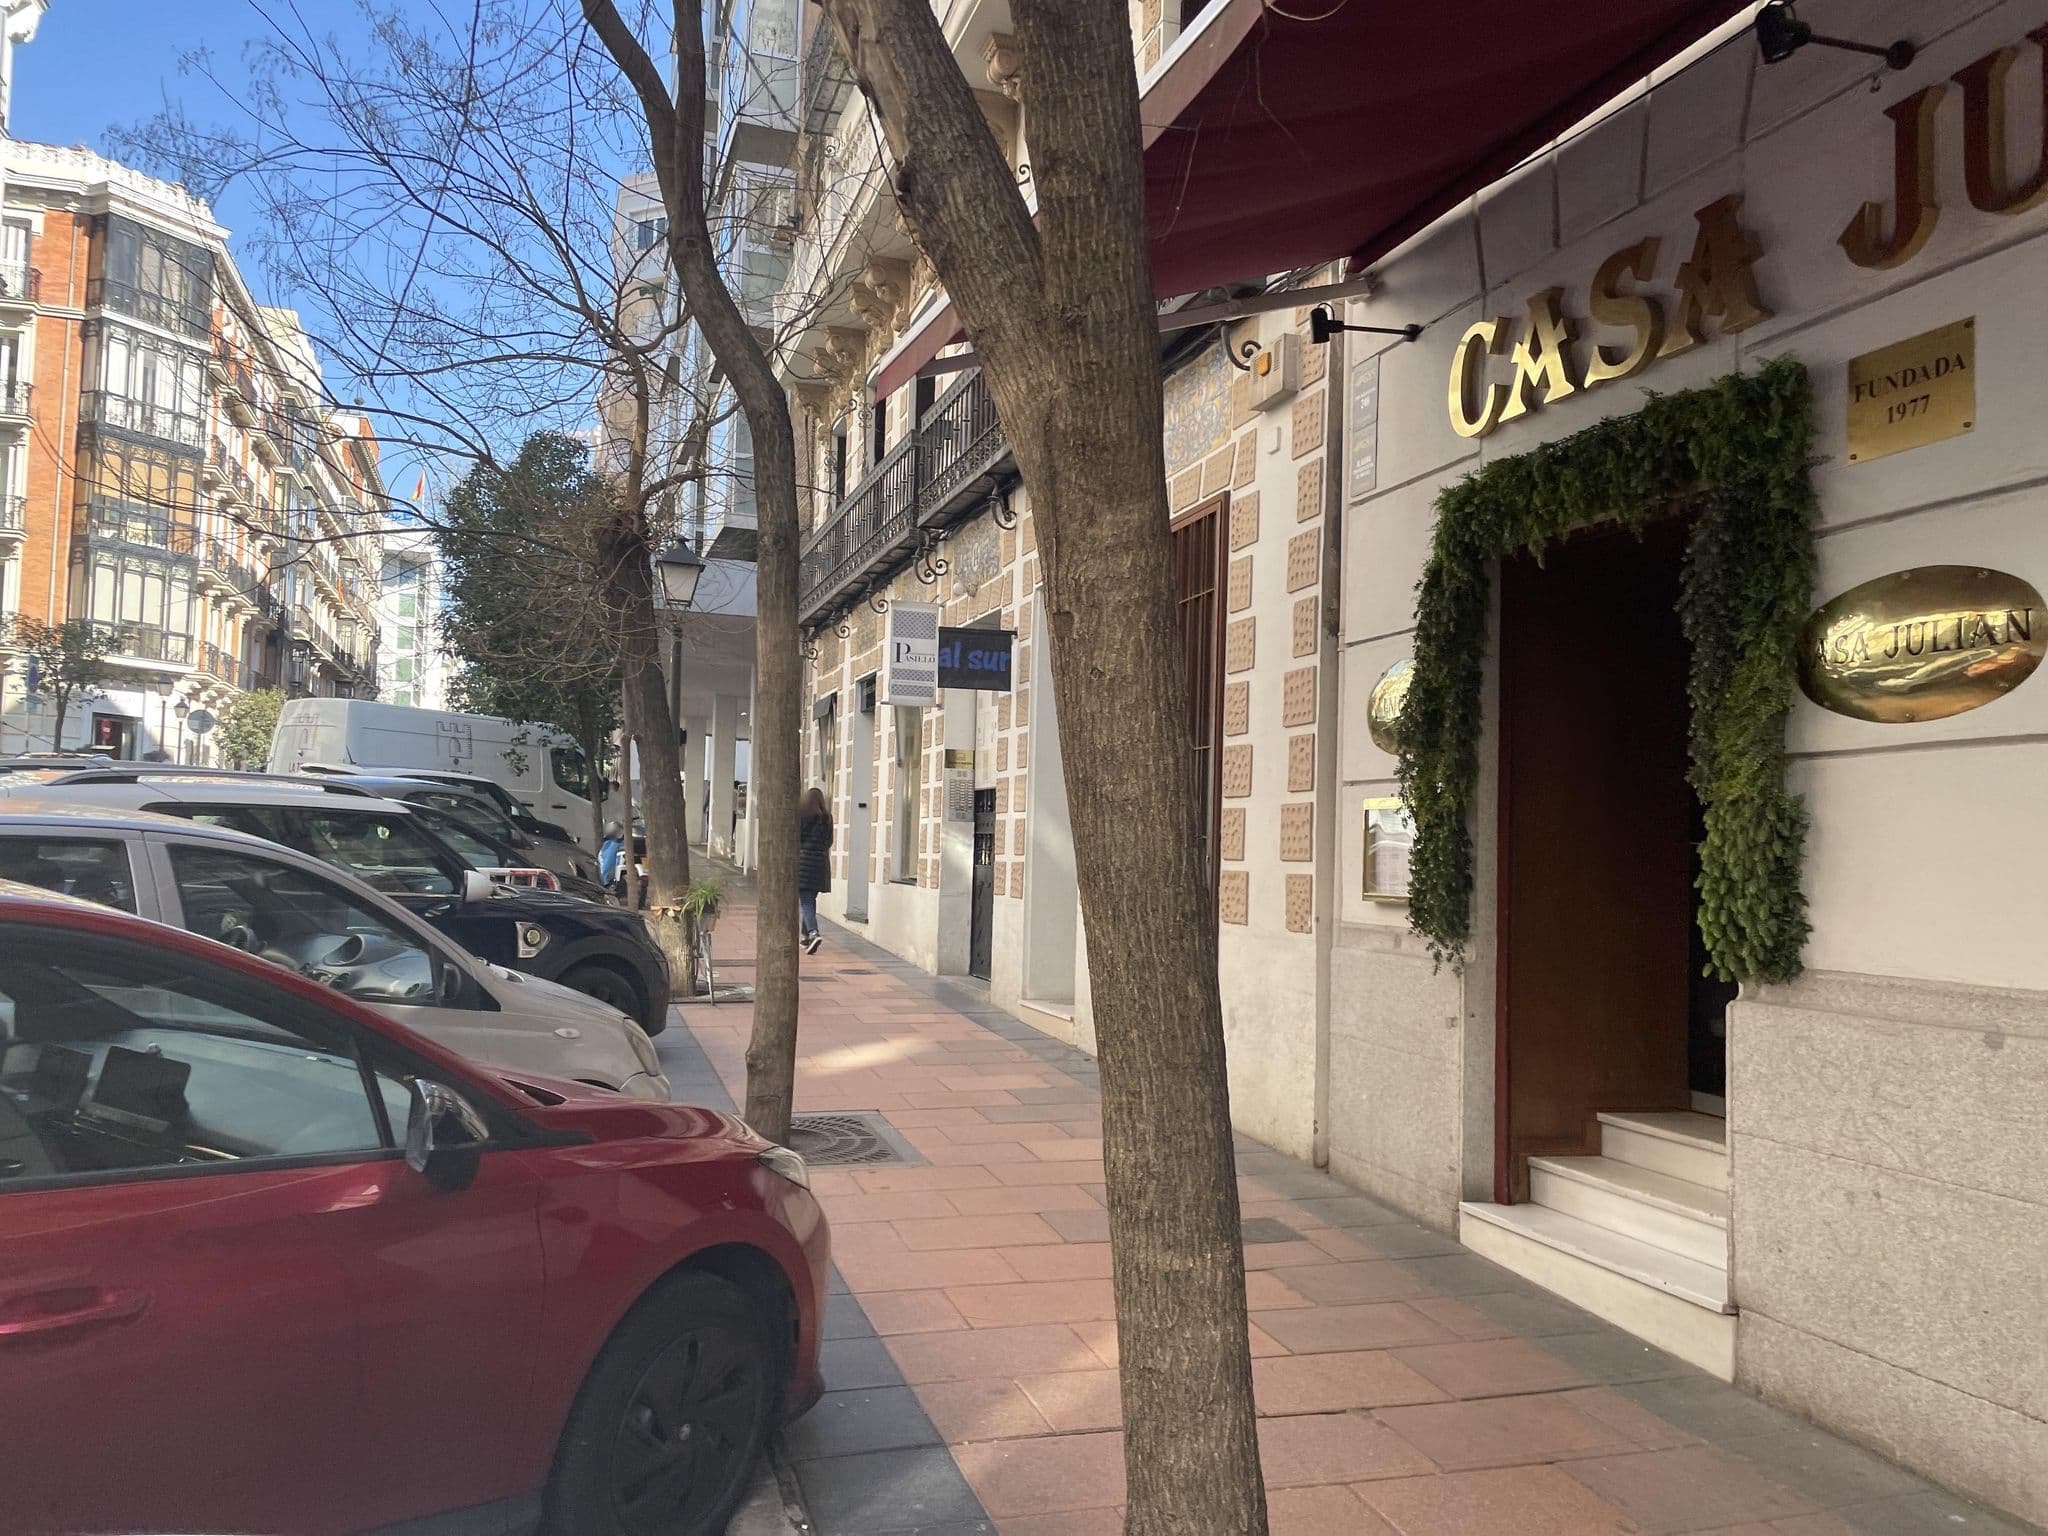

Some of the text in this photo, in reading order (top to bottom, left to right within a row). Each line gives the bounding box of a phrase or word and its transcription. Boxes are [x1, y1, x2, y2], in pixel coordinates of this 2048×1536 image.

[1447, 193, 1775, 439] CASA
[1853, 352, 1967, 405] FUNDADA
[1887, 393, 1931, 425] 1977
[967, 649, 1011, 672] sur
[1812, 607, 2034, 667] ASA JULIAN
